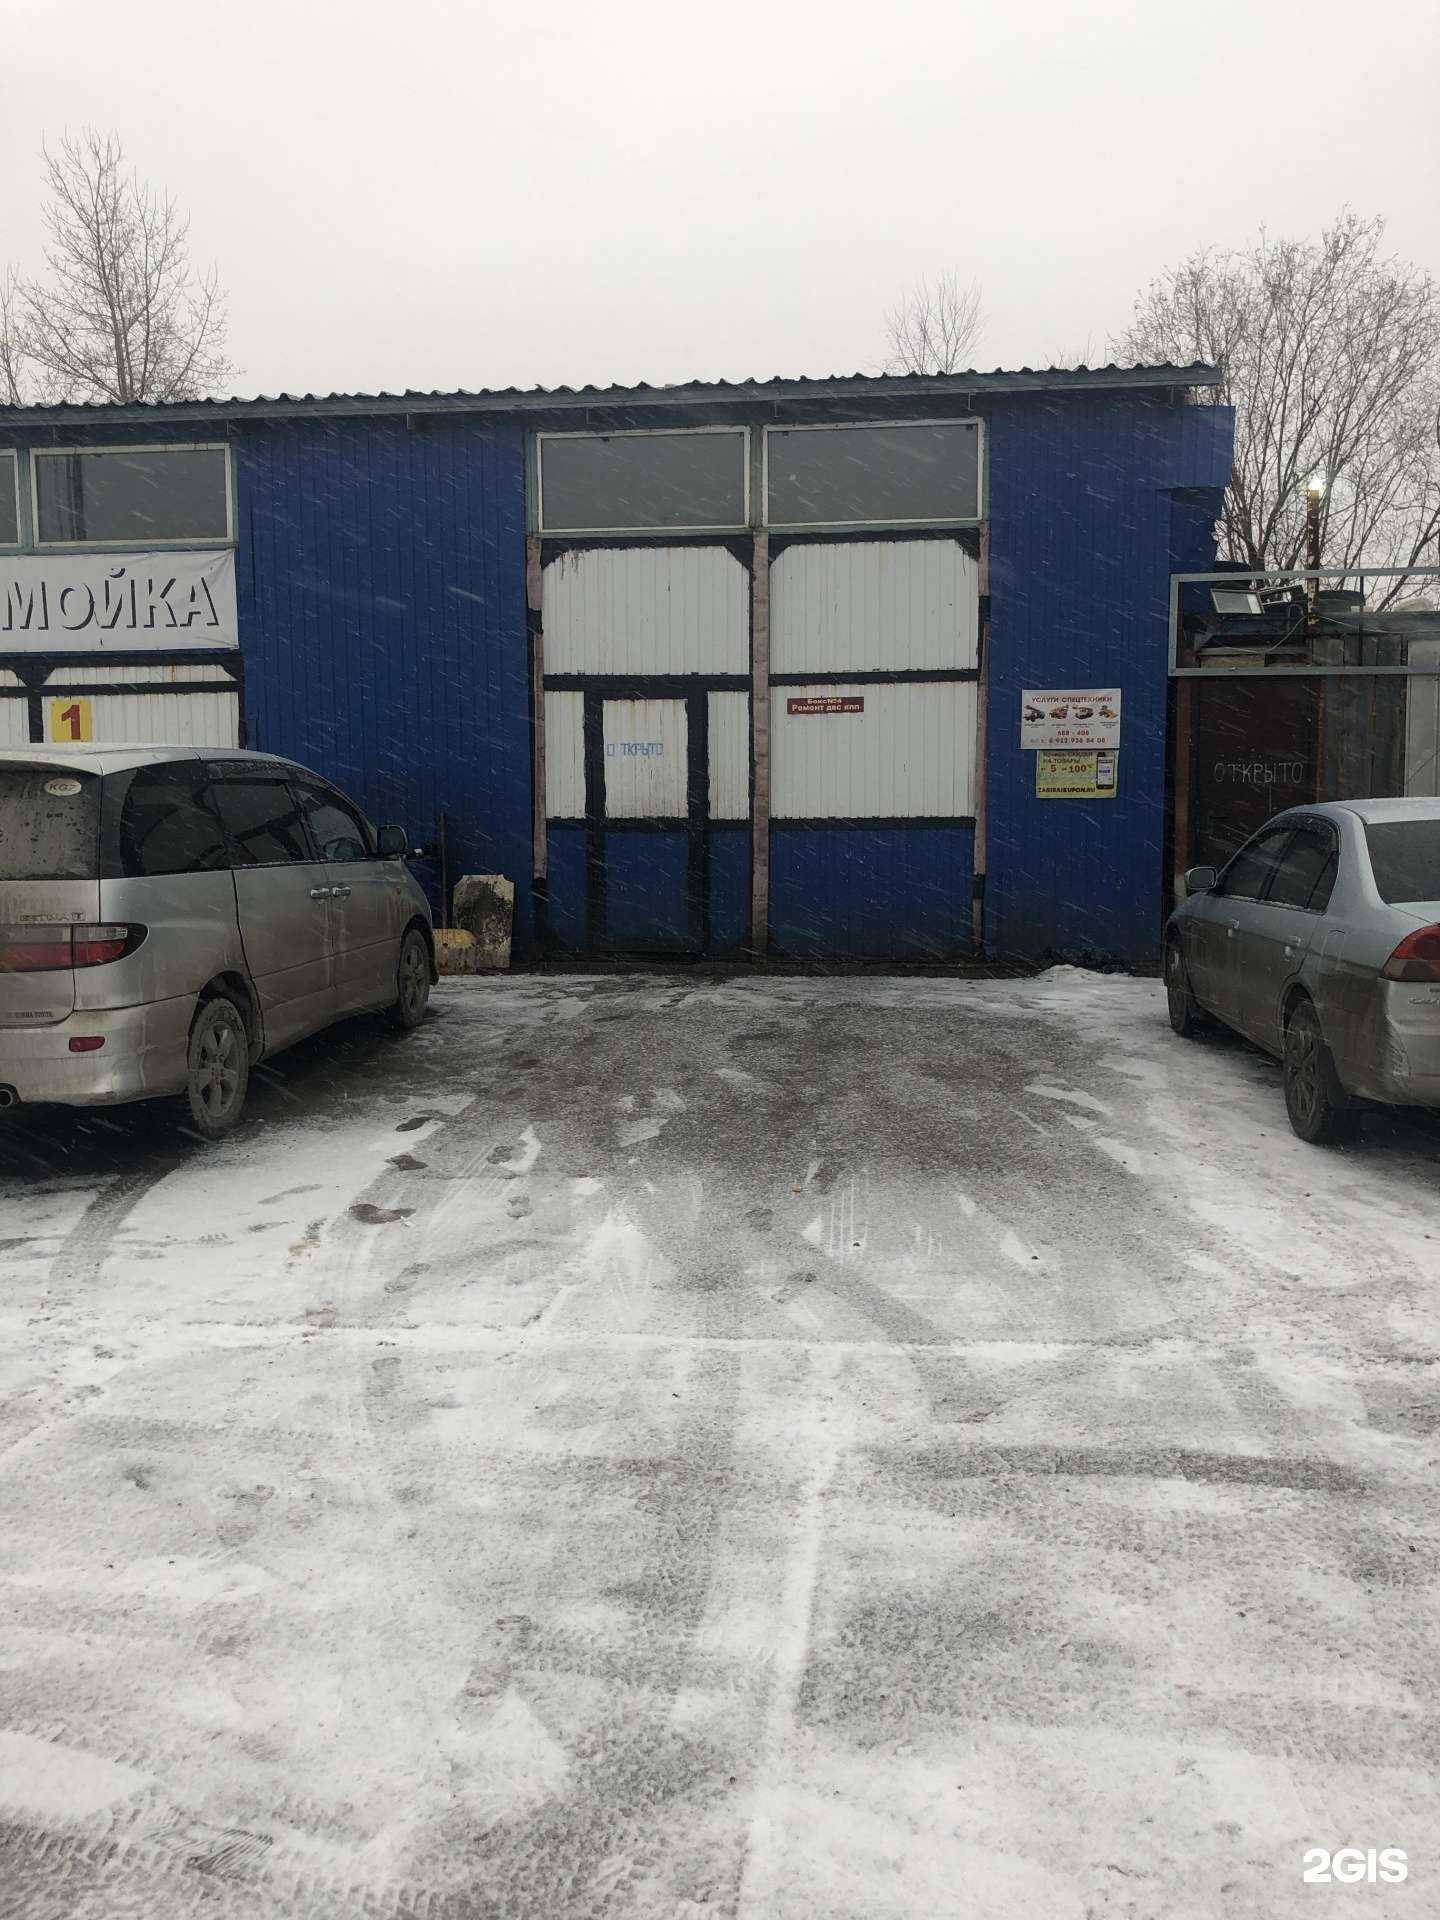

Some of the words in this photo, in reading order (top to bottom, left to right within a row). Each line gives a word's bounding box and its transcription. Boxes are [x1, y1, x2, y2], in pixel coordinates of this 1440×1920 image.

[0, 566, 219, 631] МОЙКА
[792, 704, 824, 712] Ремонт
[1031, 696, 1059, 704] УСЛУГИ
[1061, 695, 1113, 704] СПЕЦТЕХНИКИ
[61, 704, 81, 740] 1
[1215, 762, 1303, 783] ОТКРЫТО
